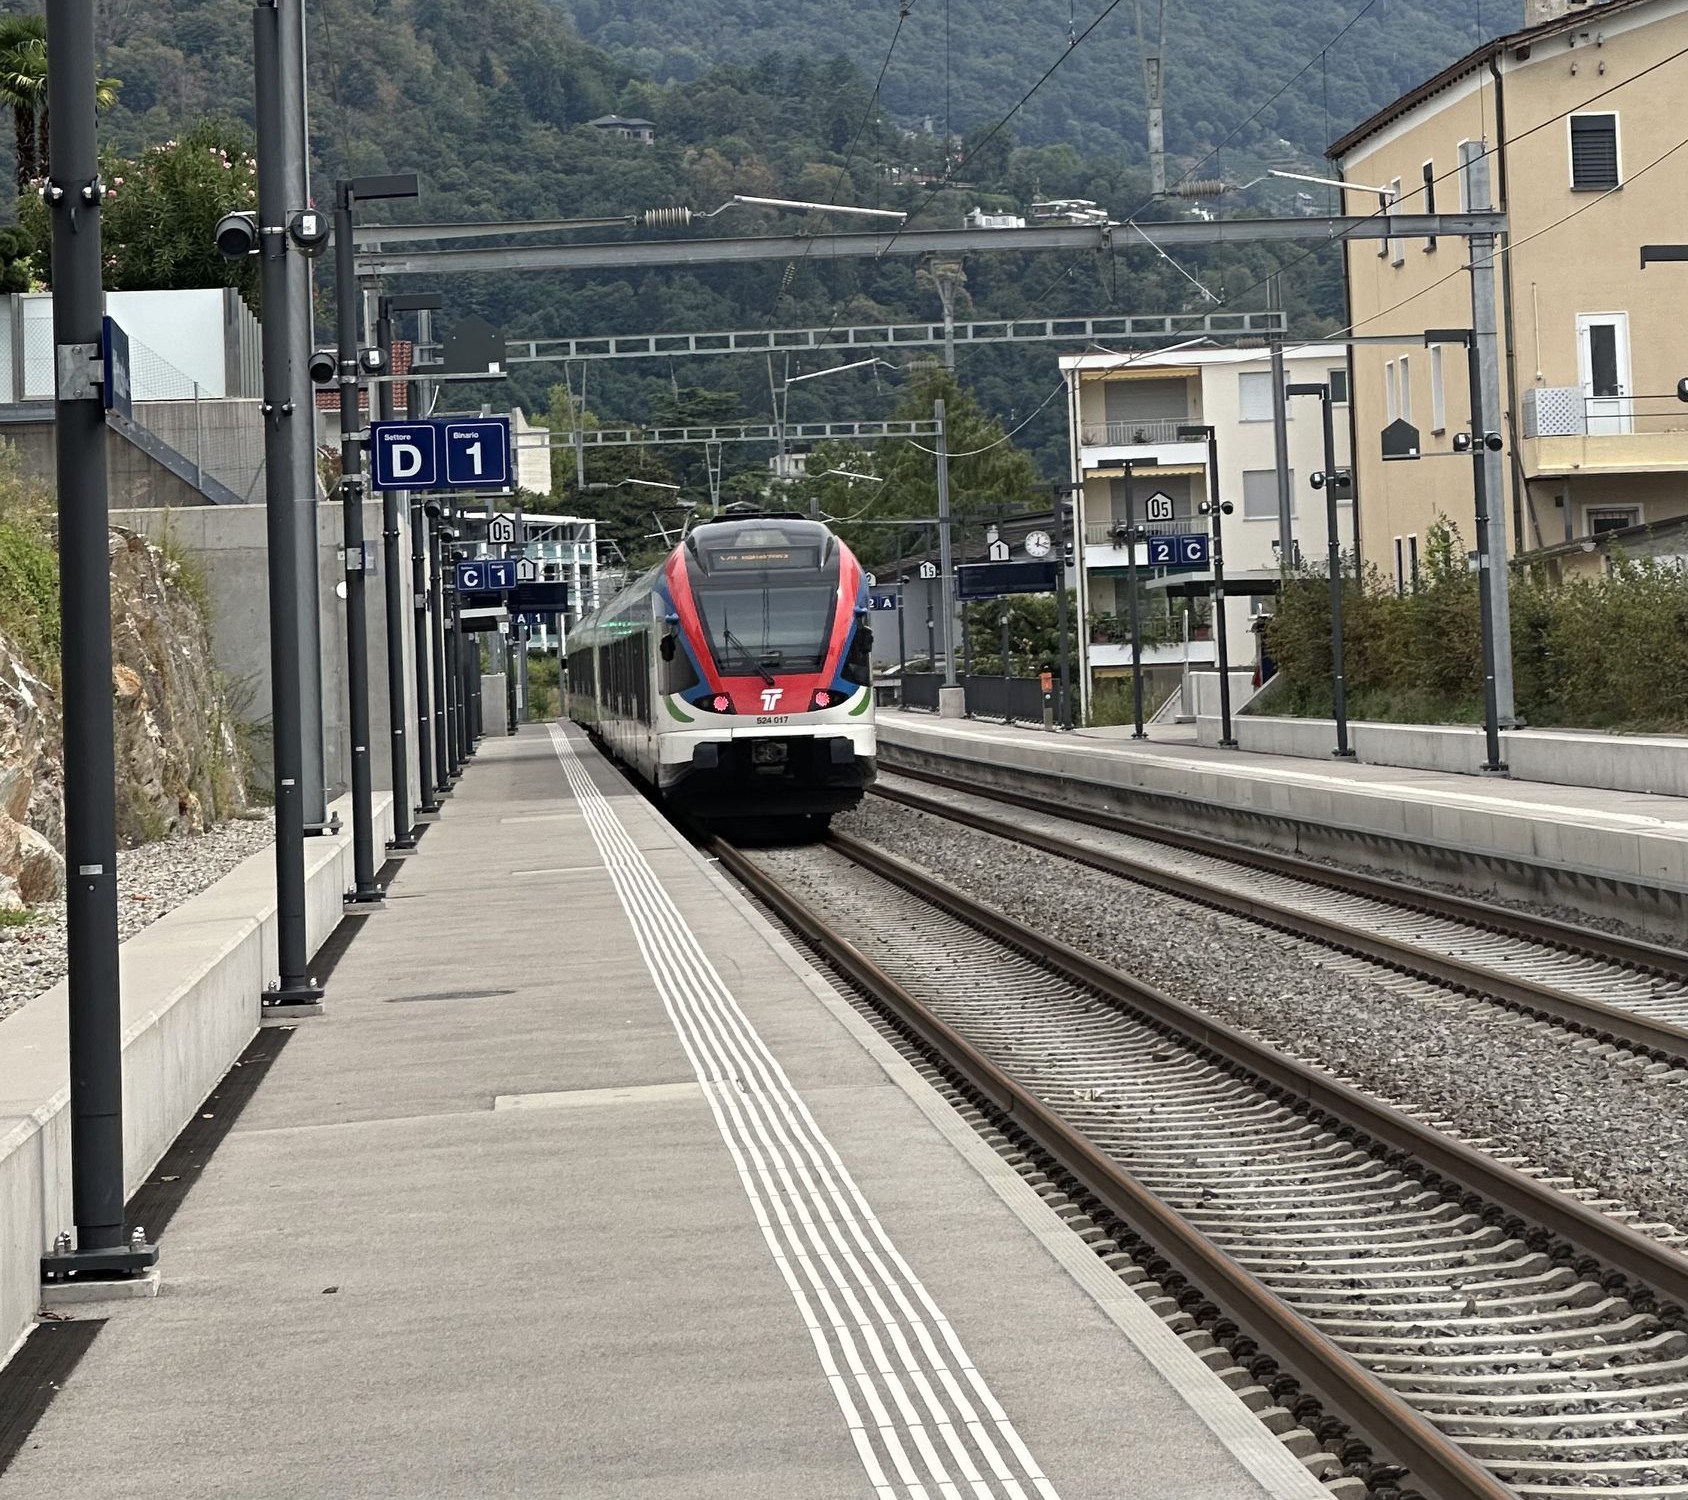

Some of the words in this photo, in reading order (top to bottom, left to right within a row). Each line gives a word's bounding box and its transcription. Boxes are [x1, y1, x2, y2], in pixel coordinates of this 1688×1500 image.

[384, 433, 411, 441] Settore
[453, 431, 479, 439] Binario
[392, 444, 422, 477] D
[465, 441, 482, 475] 1
[996, 544, 1002, 559] 1
[1158, 545, 1169, 560] 2
[1187, 543, 1201, 559] C
[497, 569, 506, 585] 1
[521, 563, 526, 577] 1
[464, 570, 478, 586] C
[883, 598, 892, 608] A
[517, 613, 526, 623] A
[535, 613, 541, 623] 1
[756, 716, 772, 725] 524
[773, 715, 789, 724] 017
